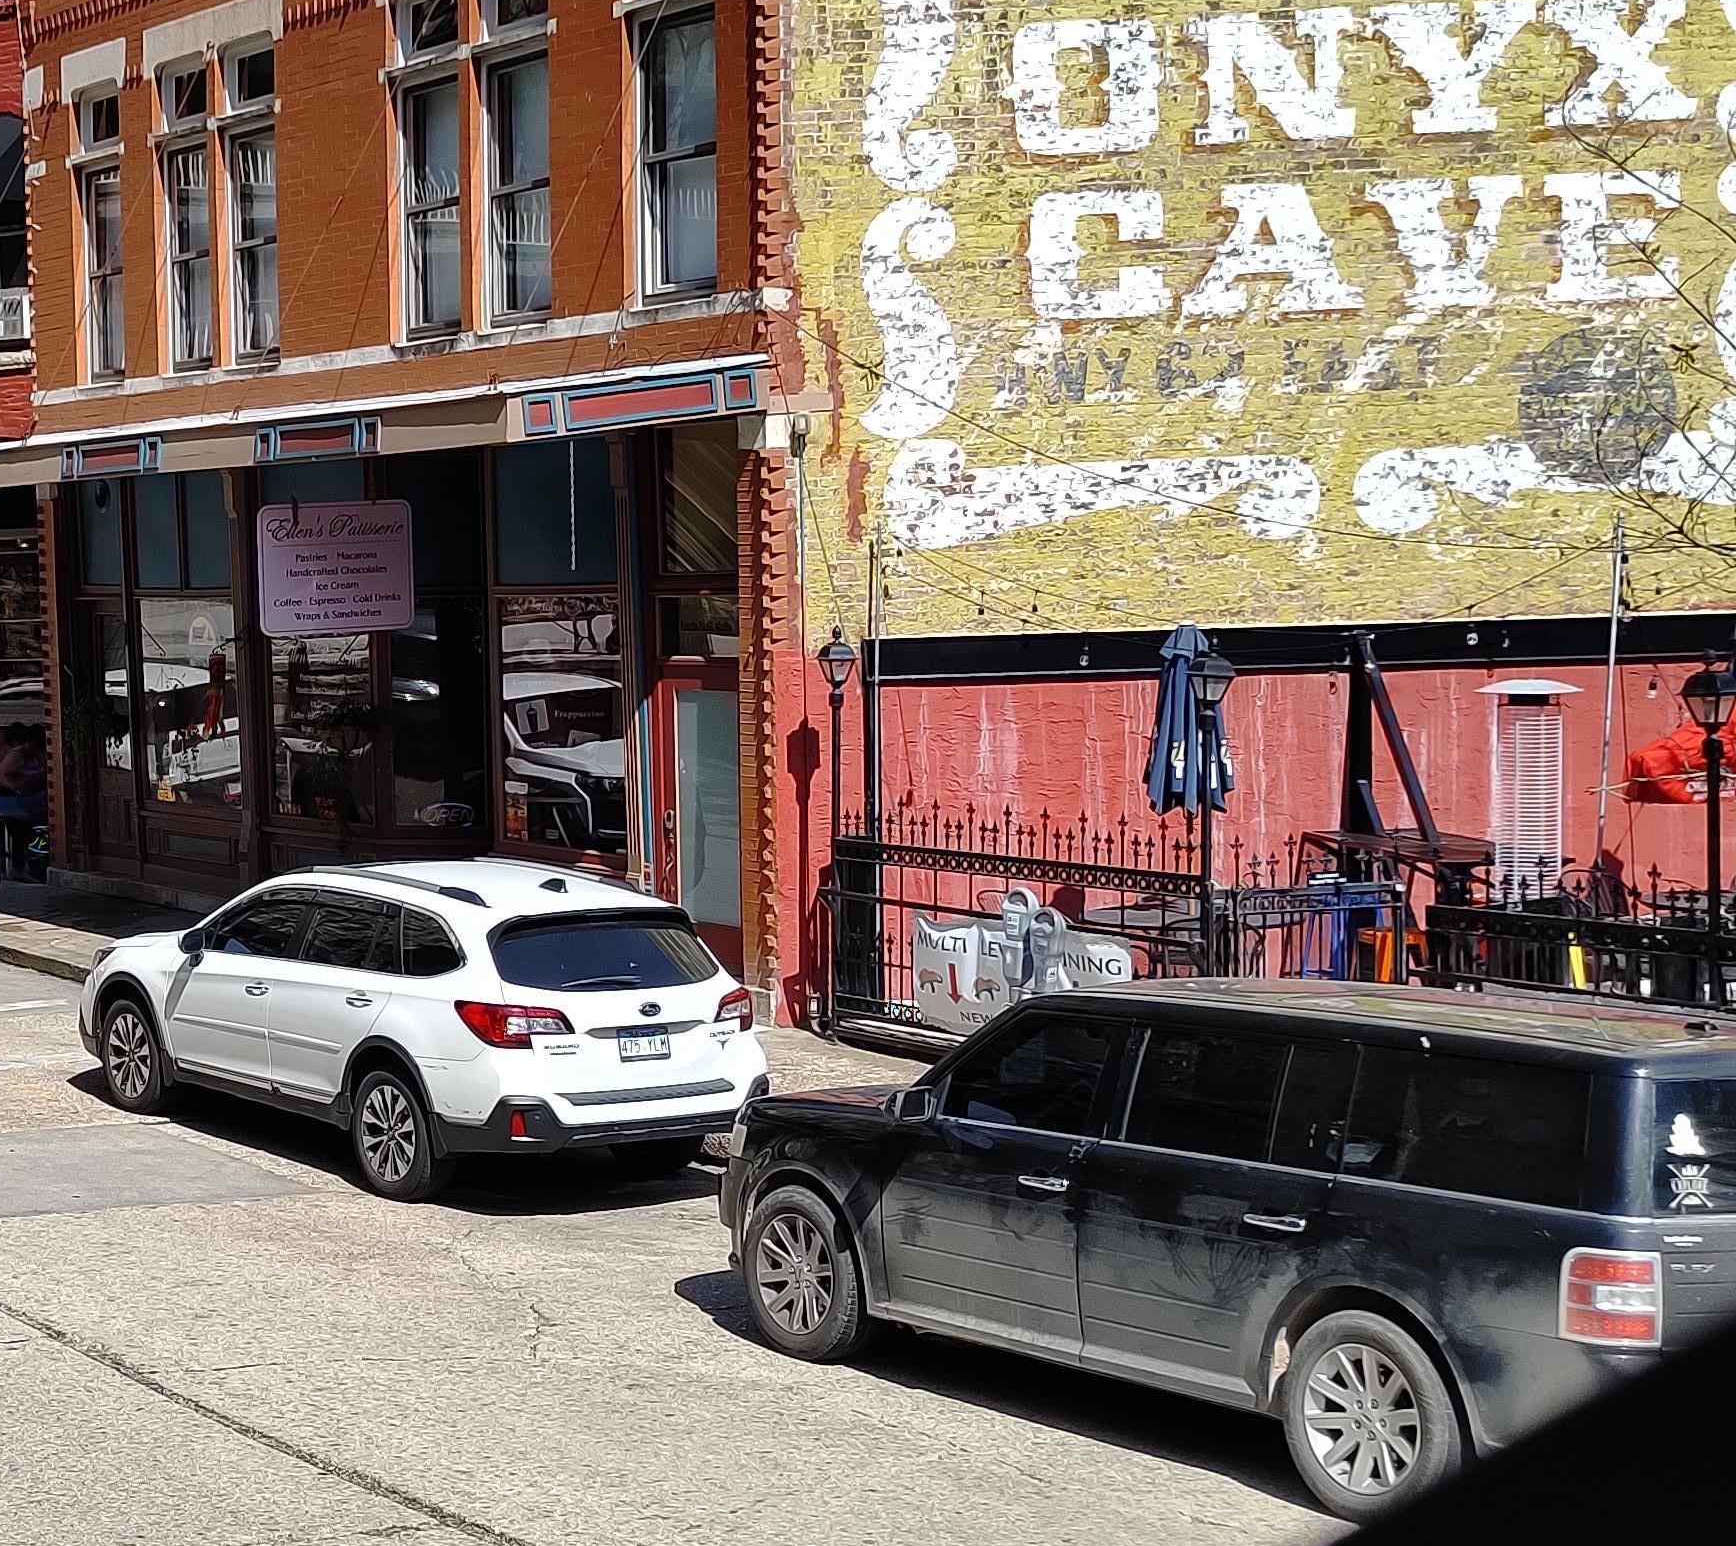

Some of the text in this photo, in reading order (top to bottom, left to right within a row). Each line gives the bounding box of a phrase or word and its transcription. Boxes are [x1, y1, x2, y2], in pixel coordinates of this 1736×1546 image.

[1028, 171, 1682, 321] CAVE
[266, 514, 404, 542] Ellen's Patisserie
[295, 553, 328, 563] Pastries
[285, 565, 388, 578] Handcrafted Chocolates
[315, 580, 360, 591] Ice Cream
[273, 592, 402, 608] Coffee Espresso Cold Drinks
[294, 611, 321, 622] Wraps
[331, 607, 382, 618] Sandwiches
[420, 808, 475, 822] OPEN
[917, 932, 967, 954] MULTI
